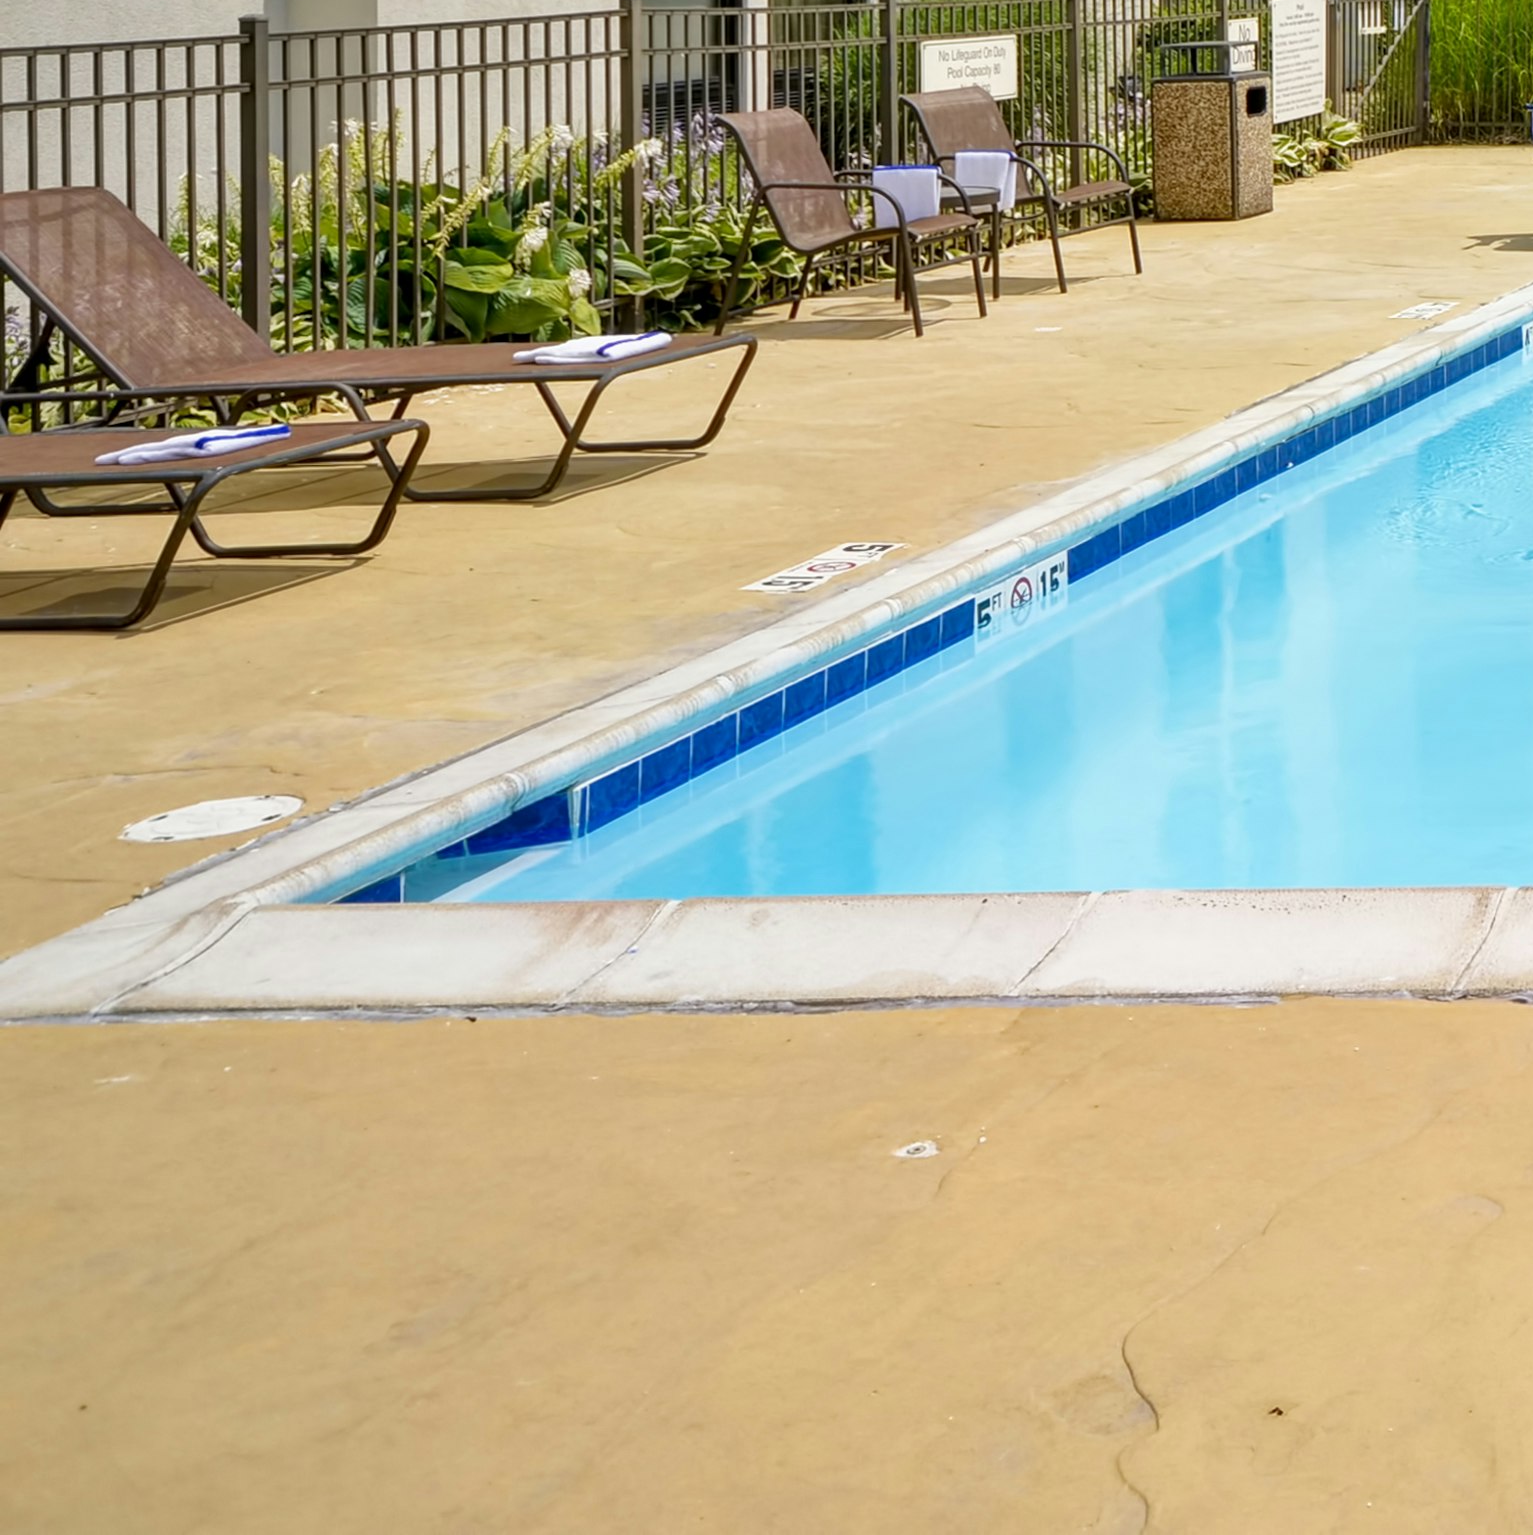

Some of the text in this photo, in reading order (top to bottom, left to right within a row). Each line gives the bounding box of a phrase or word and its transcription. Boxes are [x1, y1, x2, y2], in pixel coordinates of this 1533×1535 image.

[1238, 23, 1251, 42] No
[938, 50, 950, 62] No
[951, 48, 982, 63] Lifeguard
[983, 46, 993, 59] On
[947, 66, 963, 79] Pool
[964, 64, 992, 79] Capacity
